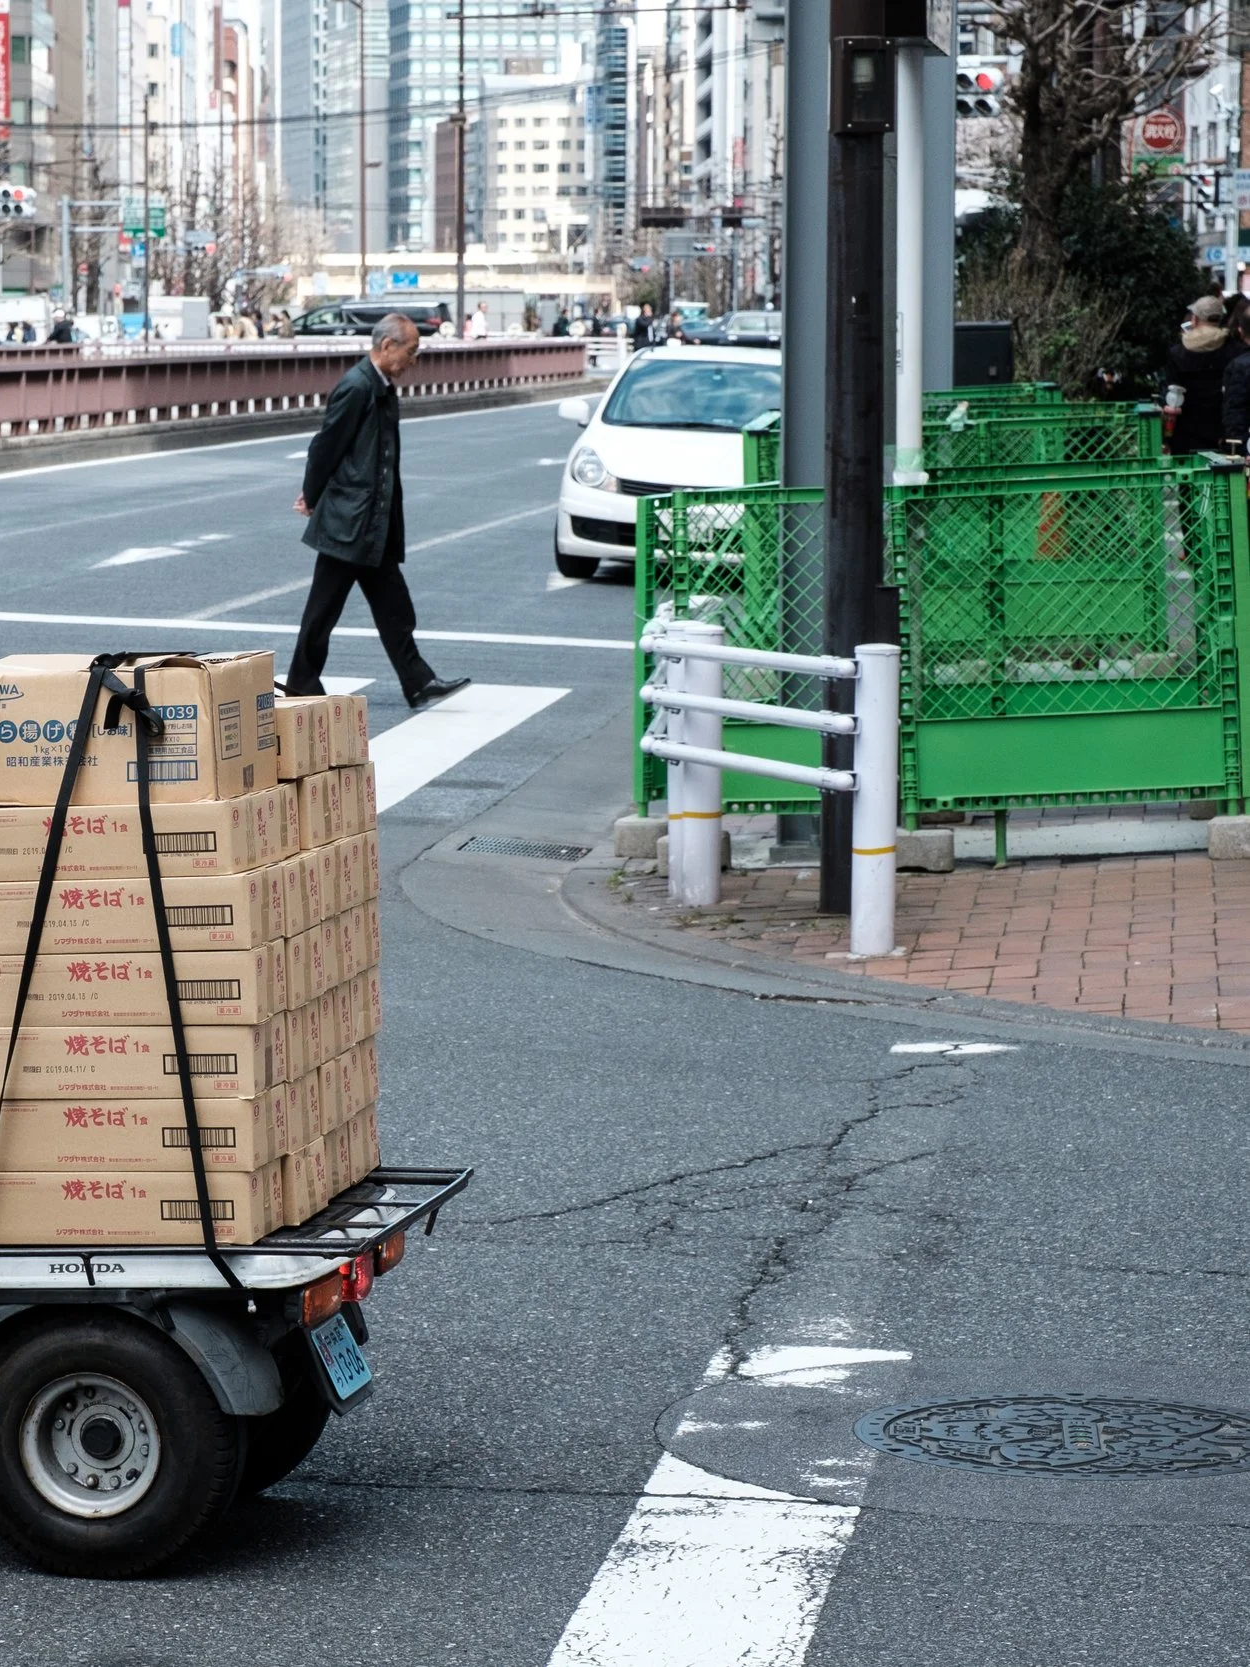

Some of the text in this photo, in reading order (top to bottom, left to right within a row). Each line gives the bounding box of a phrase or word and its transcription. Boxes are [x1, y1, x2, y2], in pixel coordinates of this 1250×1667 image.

[111, 820, 128, 832] 1食
[59, 887, 145, 910] 焼そば 1食
[54, 937, 102, 945] シマダヤ株式会社
[67, 960, 153, 982] 焼そば 1食
[62, 1010, 110, 1018] シマダヤ株式会社
[64, 1034, 150, 1056] 焼そば 1食
[63, 1106, 148, 1128] 焼そば 1食
[61, 1179, 147, 1201] 焼そば 1食
